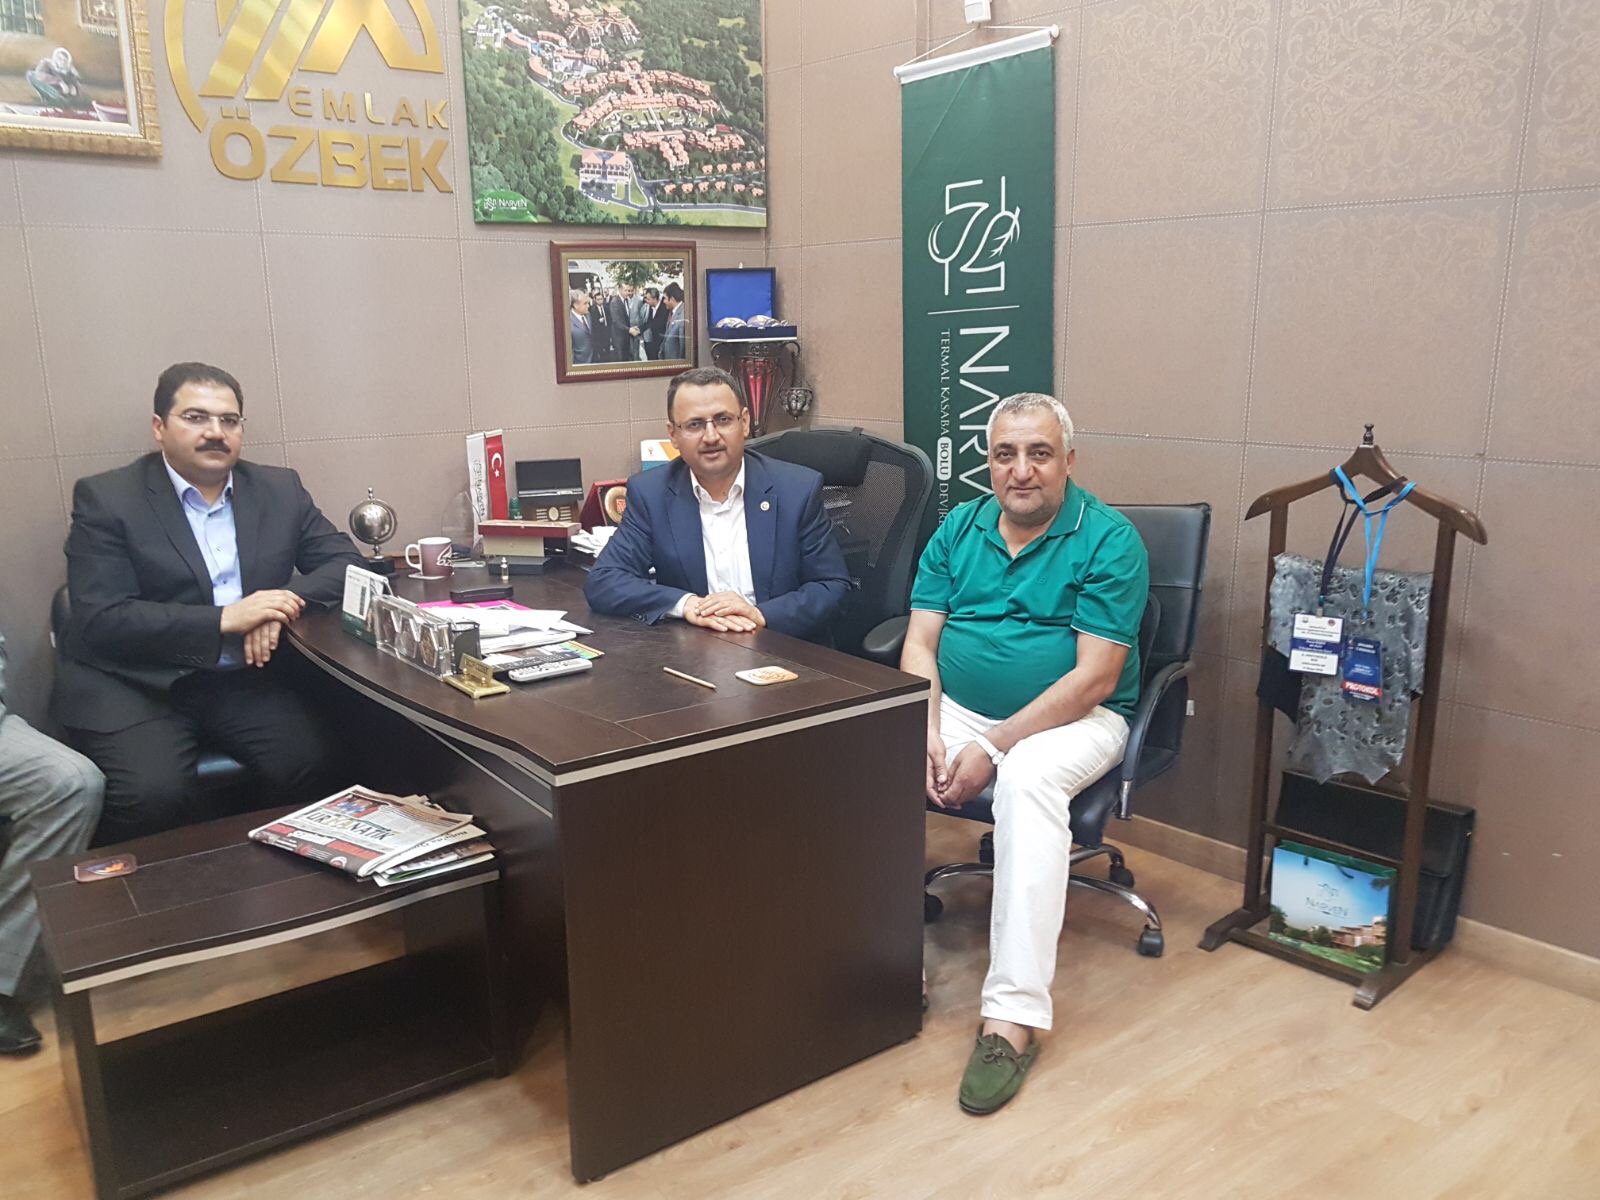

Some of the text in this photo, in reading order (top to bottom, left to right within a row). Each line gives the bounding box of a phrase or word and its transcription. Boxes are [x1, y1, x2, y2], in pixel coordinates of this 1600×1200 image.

[288, 87, 449, 129] EMLAK
[208, 105, 453, 193] ÖZBEK
[940, 328, 950, 383] TERMAL
[939, 386, 950, 436] KASABA
[959, 326, 1009, 505] NARV
[939, 442, 949, 476] BOLU
